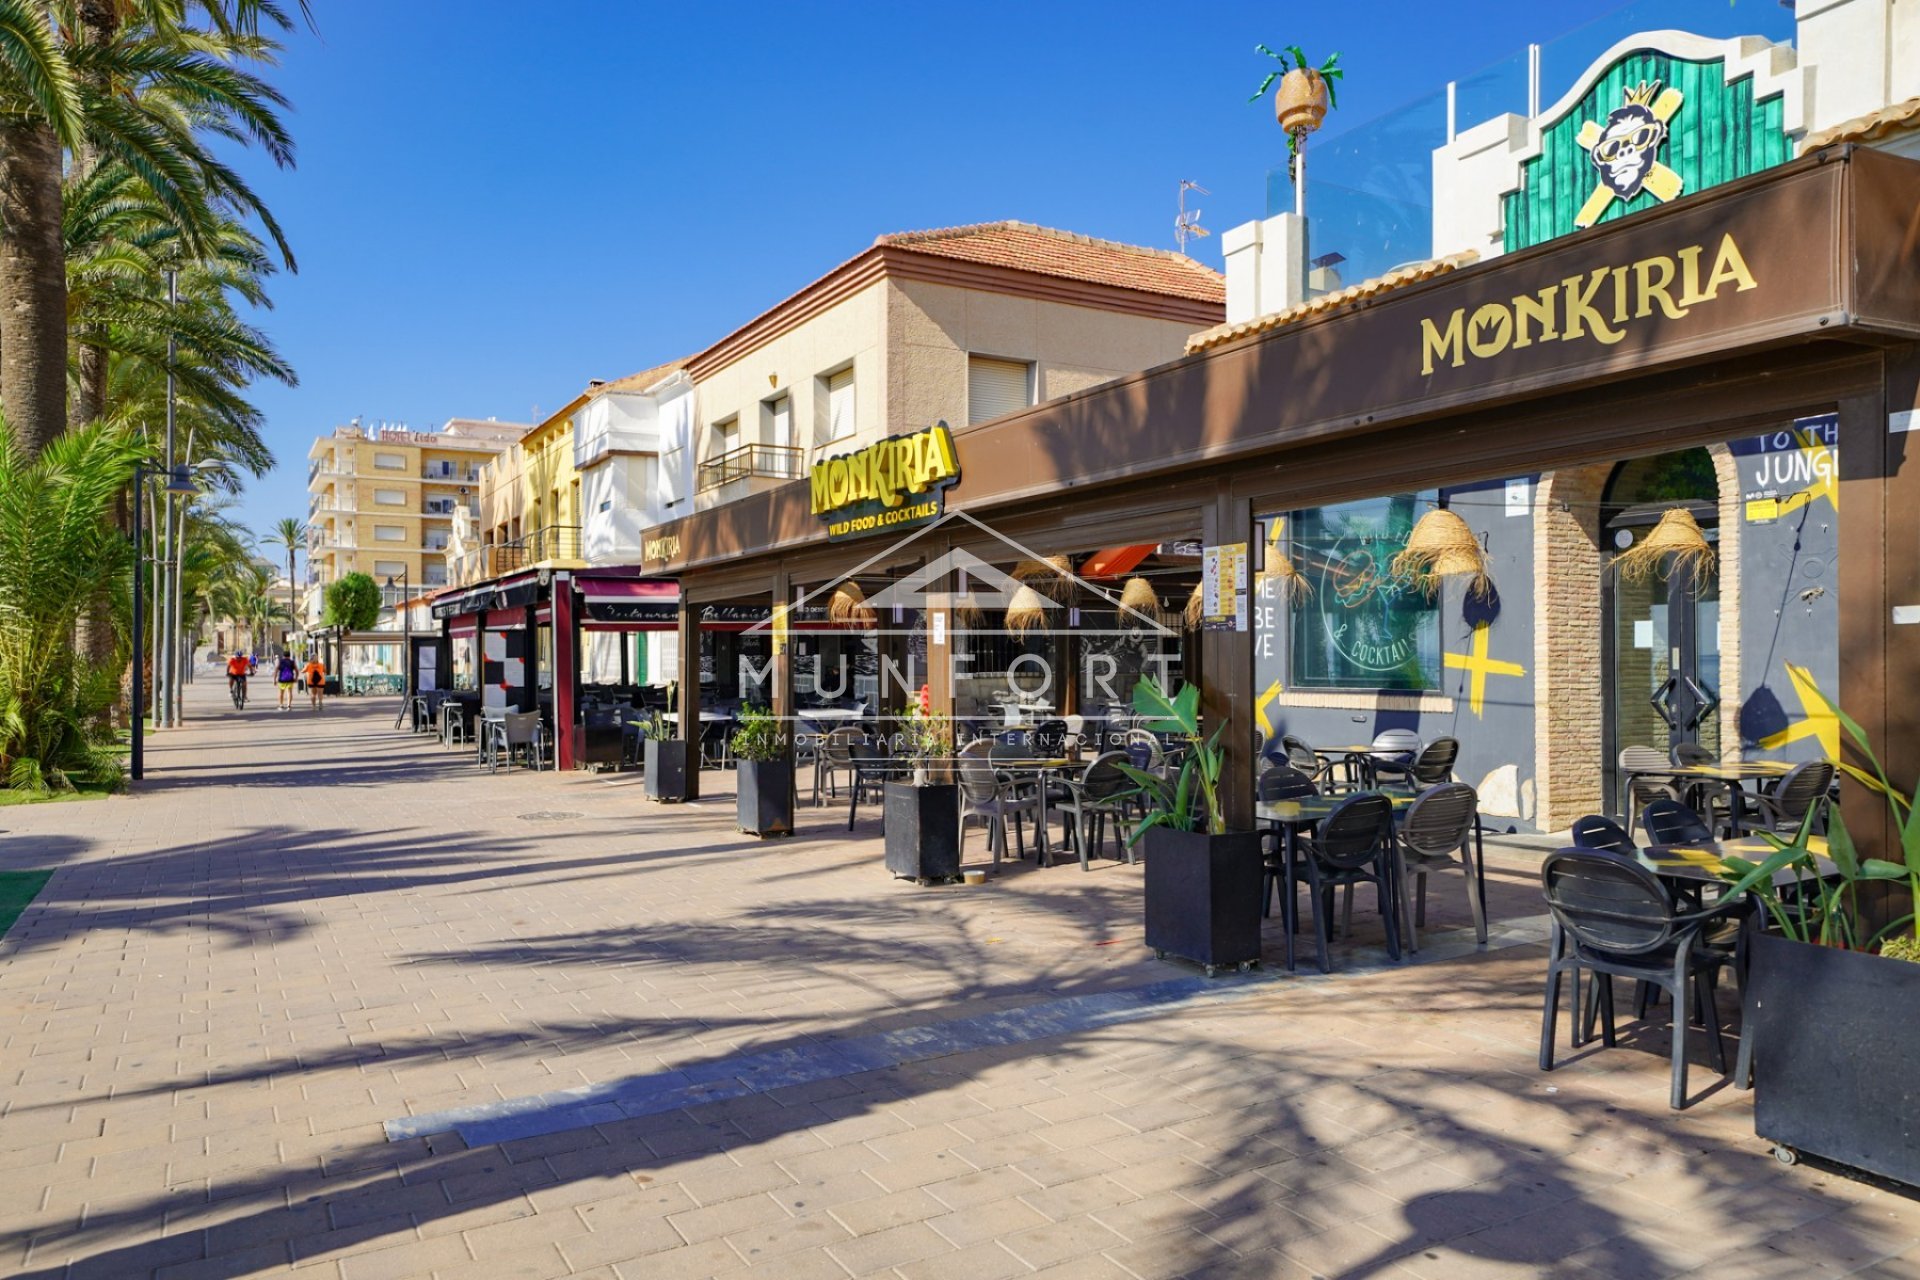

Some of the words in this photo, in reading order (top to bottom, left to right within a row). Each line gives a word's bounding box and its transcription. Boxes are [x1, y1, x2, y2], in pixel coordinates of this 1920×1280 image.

[1420, 233, 1757, 376] MONKIRIA
[381, 430, 412, 443] HOTEL
[1760, 431, 1790, 452] TO
[1801, 422, 1838, 447] TH
[810, 426, 955, 514] MONKIRIA
[1755, 450, 1838, 488] JUNG
[829, 522, 850, 537] WILD
[851, 516, 876, 532] FOOD
[877, 514, 884, 526] &
[885, 501, 938, 523] COCKTAILS
[645, 535, 680, 561] MONKIRIA
